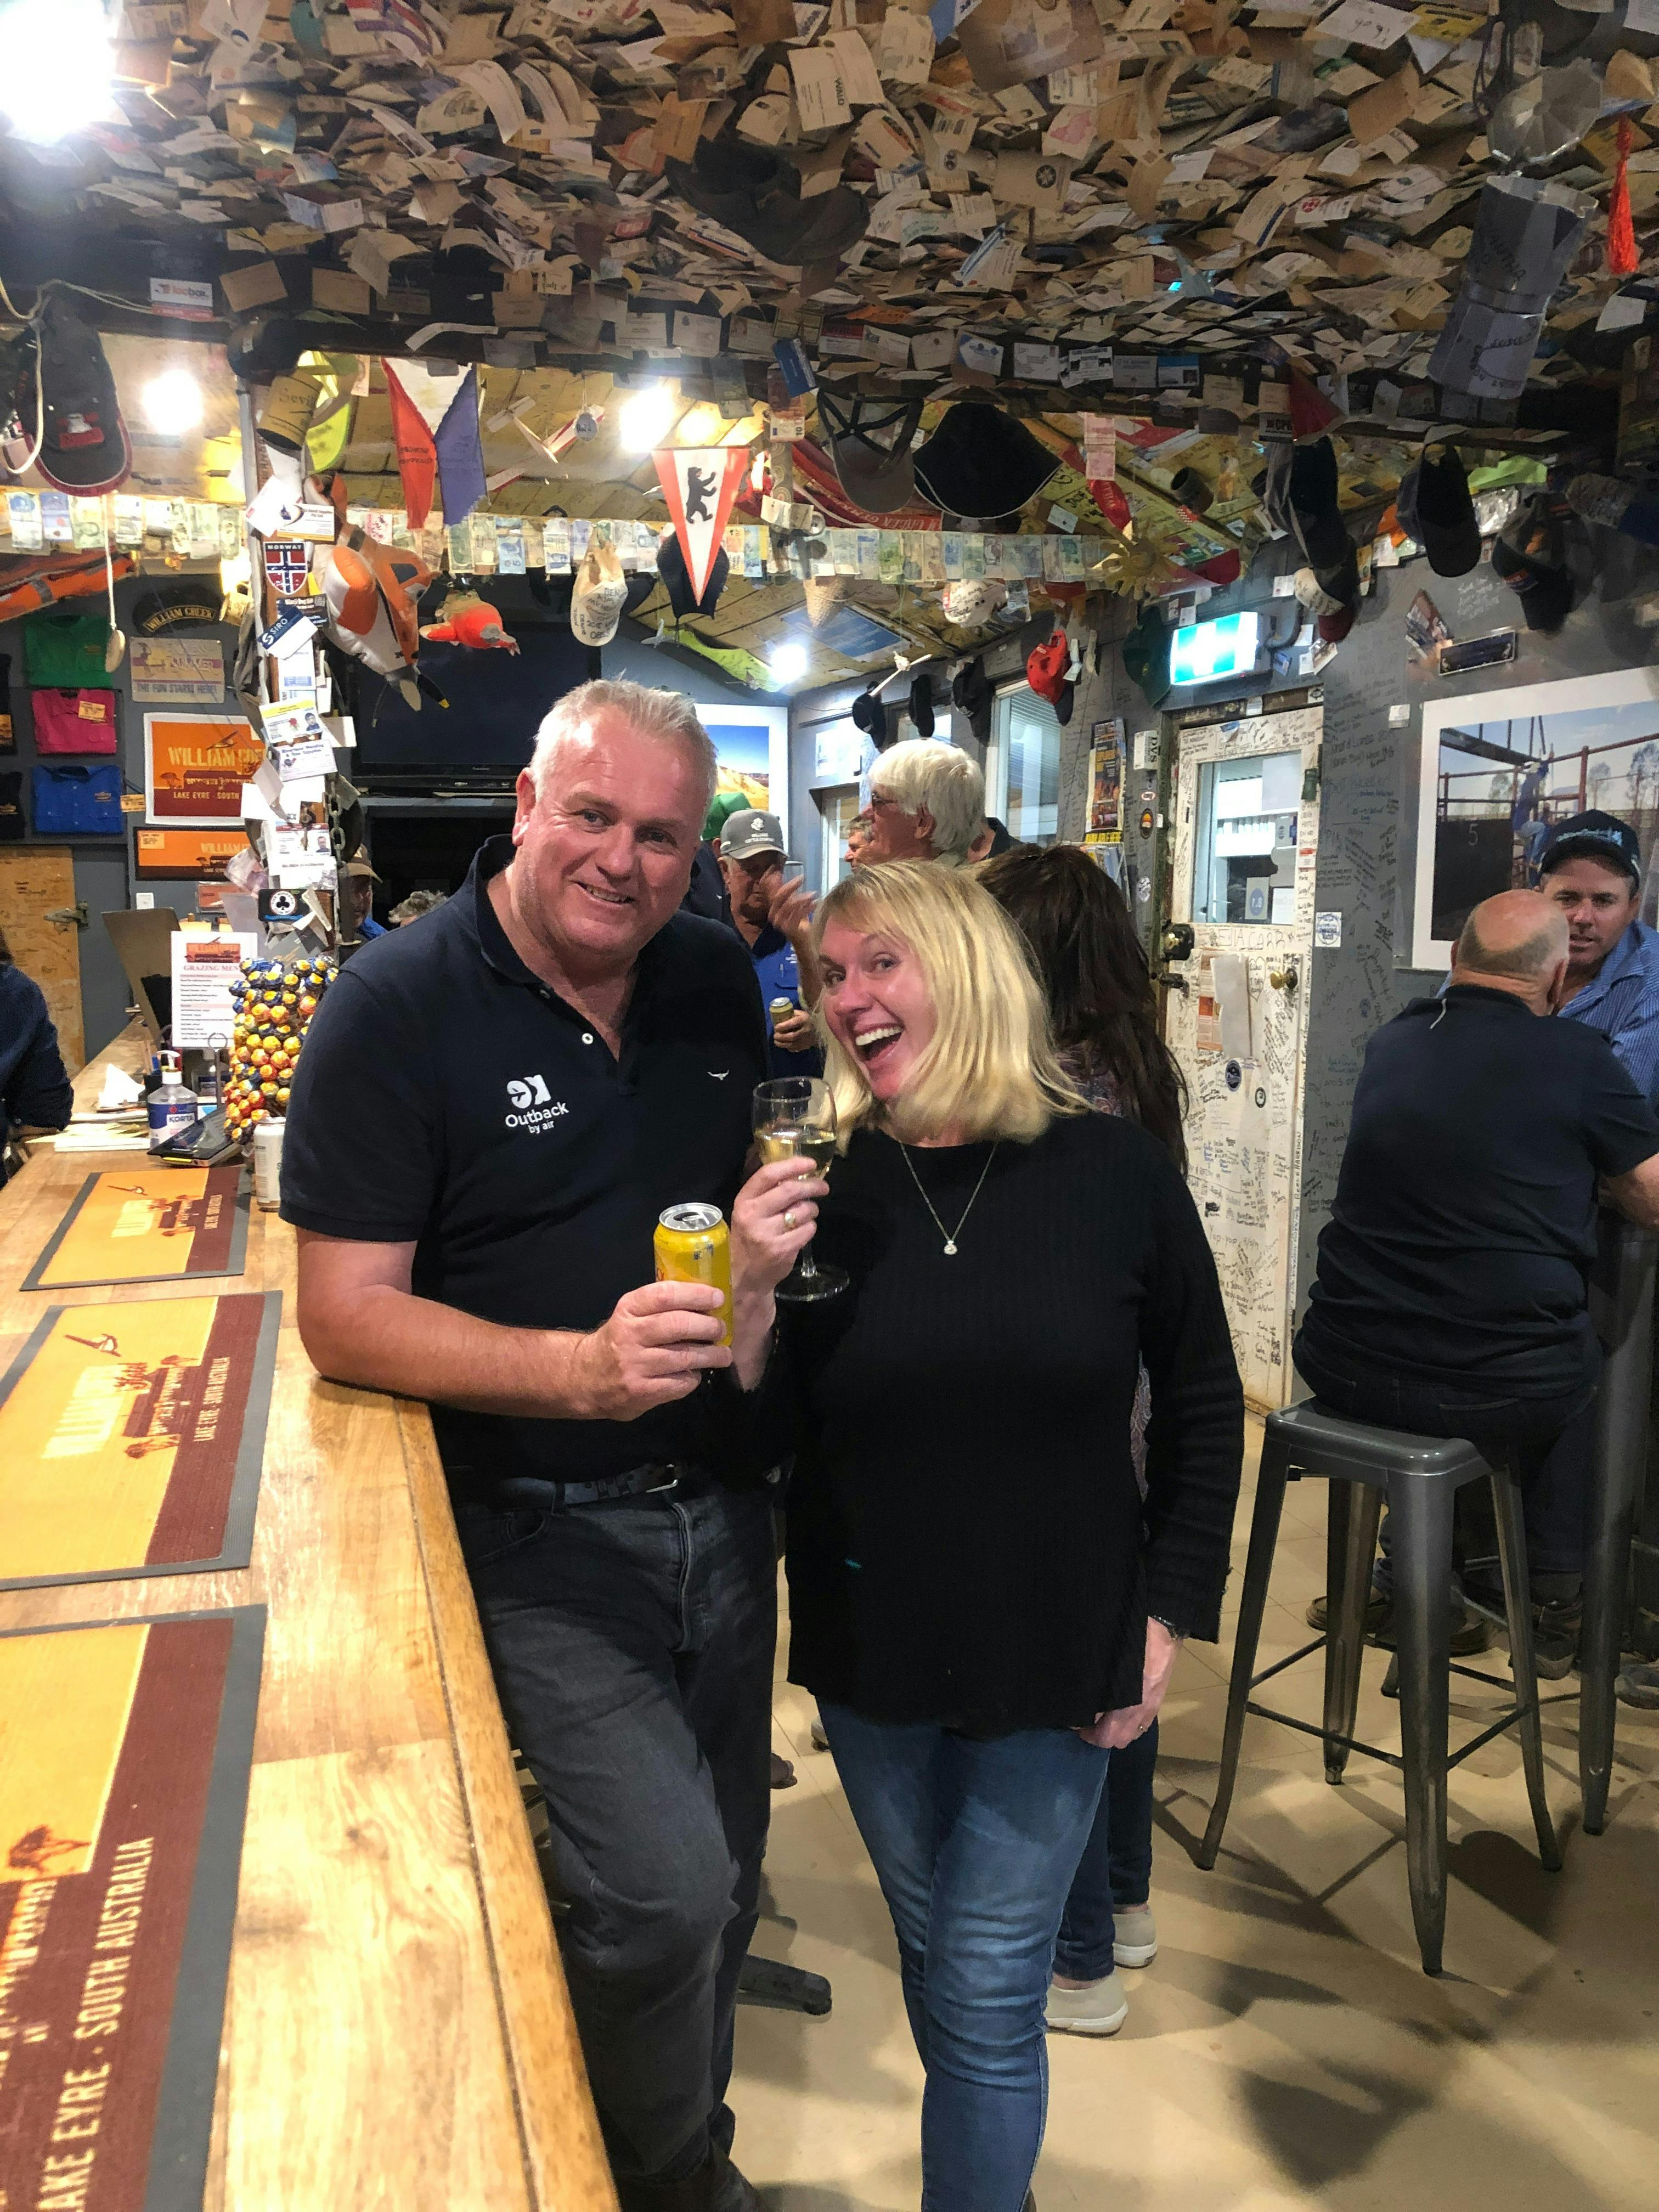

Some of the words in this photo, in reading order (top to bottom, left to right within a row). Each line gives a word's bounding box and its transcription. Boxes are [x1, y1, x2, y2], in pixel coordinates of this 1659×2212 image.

[146, 607, 183, 630] WILLIAM
[184, 606, 213, 619] CREEK
[269, 618, 288, 635] SIRO
[138, 684, 150, 693] THE
[152, 684, 167, 693] FUN
[167, 746, 235, 766] WILLIAM
[1150, 736, 1158, 763] DVS
[173, 791, 190, 799] LAKE
[192, 791, 211, 799] EYRE
[217, 792, 240, 800] SOUTH
[1468, 824, 1479, 847] 5
[505, 1102, 569, 1127] Outback
[528, 1125, 540, 1134] by
[542, 1120, 555, 1130] air
[206, 1357, 230, 1386] AUSTRALIA
[202, 1384, 225, 1406] SOUTH
[197, 1408, 220, 1425] EYRE
[193, 1425, 217, 1442] LAKE
[92, 1836, 155, 1951] AUSTRALIA
[73, 1954, 132, 2041] SOUTH
[50, 2061, 111, 2142] EYRE
[37, 2147, 96, 2212] AKE
